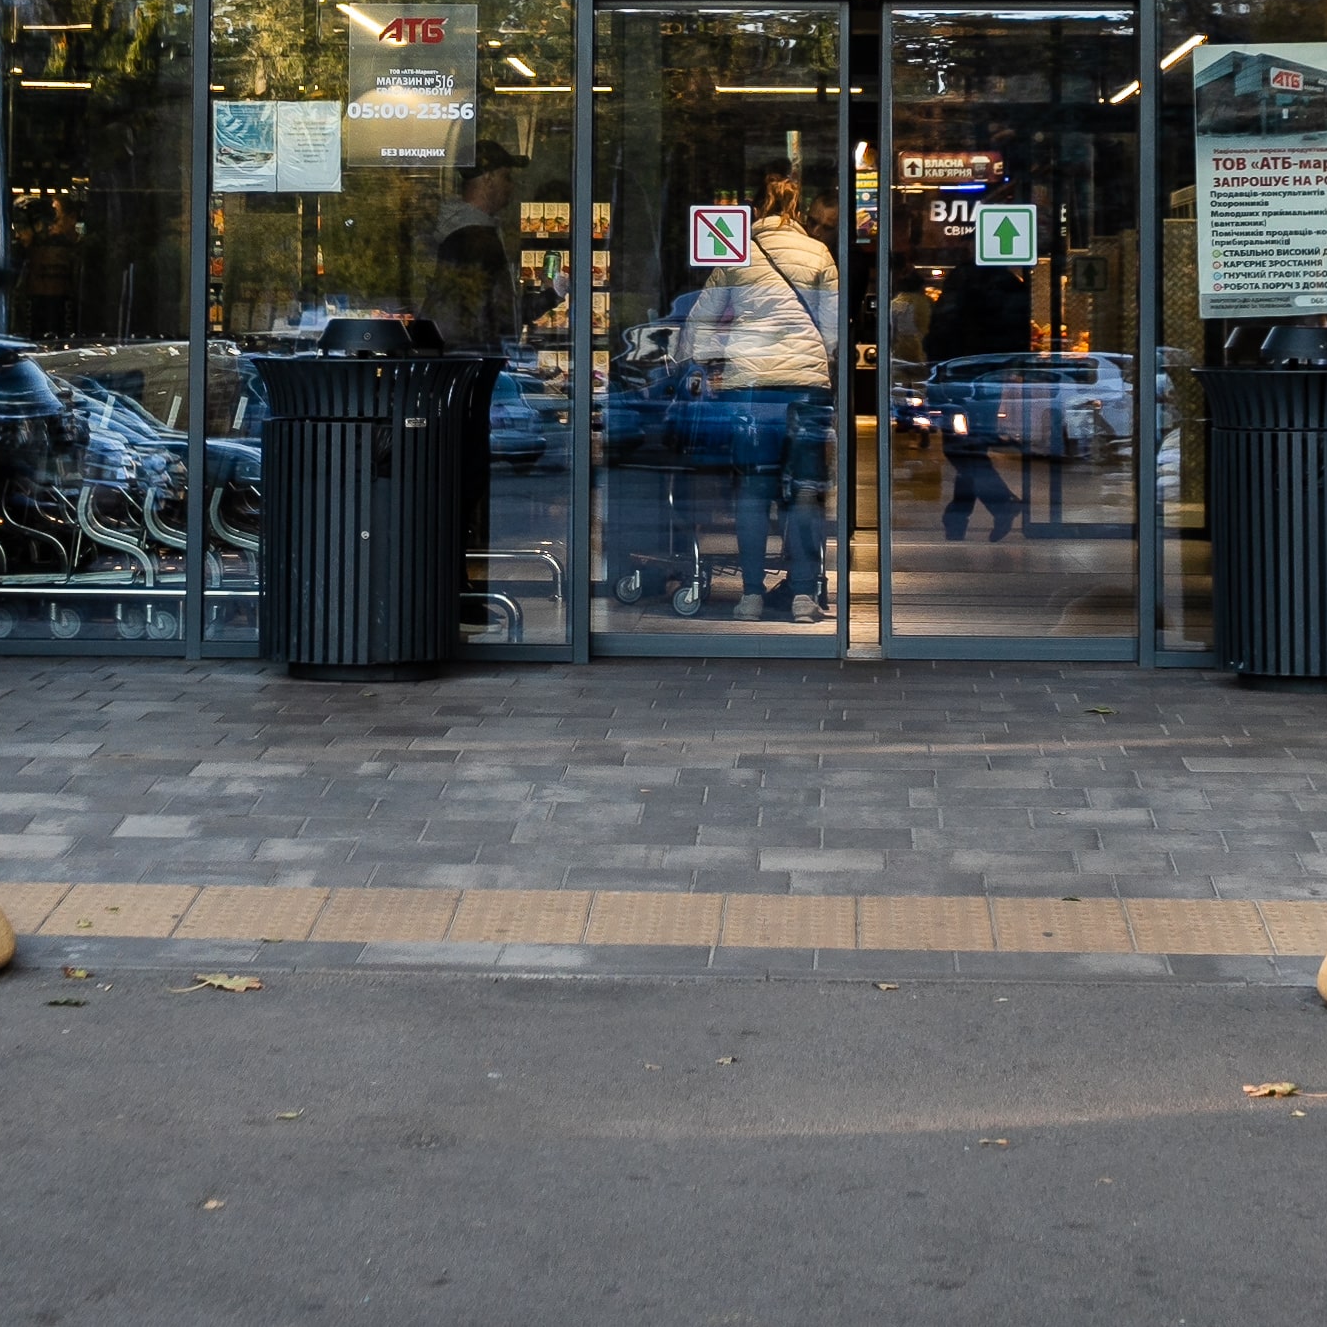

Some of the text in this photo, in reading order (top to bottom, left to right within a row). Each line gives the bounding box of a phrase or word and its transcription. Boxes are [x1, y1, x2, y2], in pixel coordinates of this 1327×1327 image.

[378, 17, 449, 44] АТБ
[376, 76, 423, 86] МАГАЗИН
[435, 74, 454, 88] 516
[1272, 71, 1301, 89] АТБ
[347, 102, 475, 120] 05:00-23:56
[381, 148, 446, 159] БЕЗ ВИХІДНИХ
[924, 158, 964, 168] ВЛАСНА
[1212, 157, 1247, 171] ТОВ
[1213, 176, 1290, 187] ЗАПРОШУЄ
[1293, 176, 1312, 186] НА
[1210, 189, 1325, 199] Продавців-консультантів
[1210, 199, 1270, 208] Охоронників
[1210, 210, 1260, 219] Молодших
[1211, 230, 1264, 238] Помічників
[1223, 249, 1275, 257] СТАБІЛЬНО
[1276, 247, 1321, 257] ВИСОКИЙ
[1268, 259, 1323, 267] ЗРОСТАННЯ
[1223, 270, 1267, 279] ГНУЧКИЙ
[1268, 270, 1302, 279] ГРАФІК
[1223, 282, 1260, 290] РОБОТА
[1262, 281, 1294, 290] ПОРУЧ
